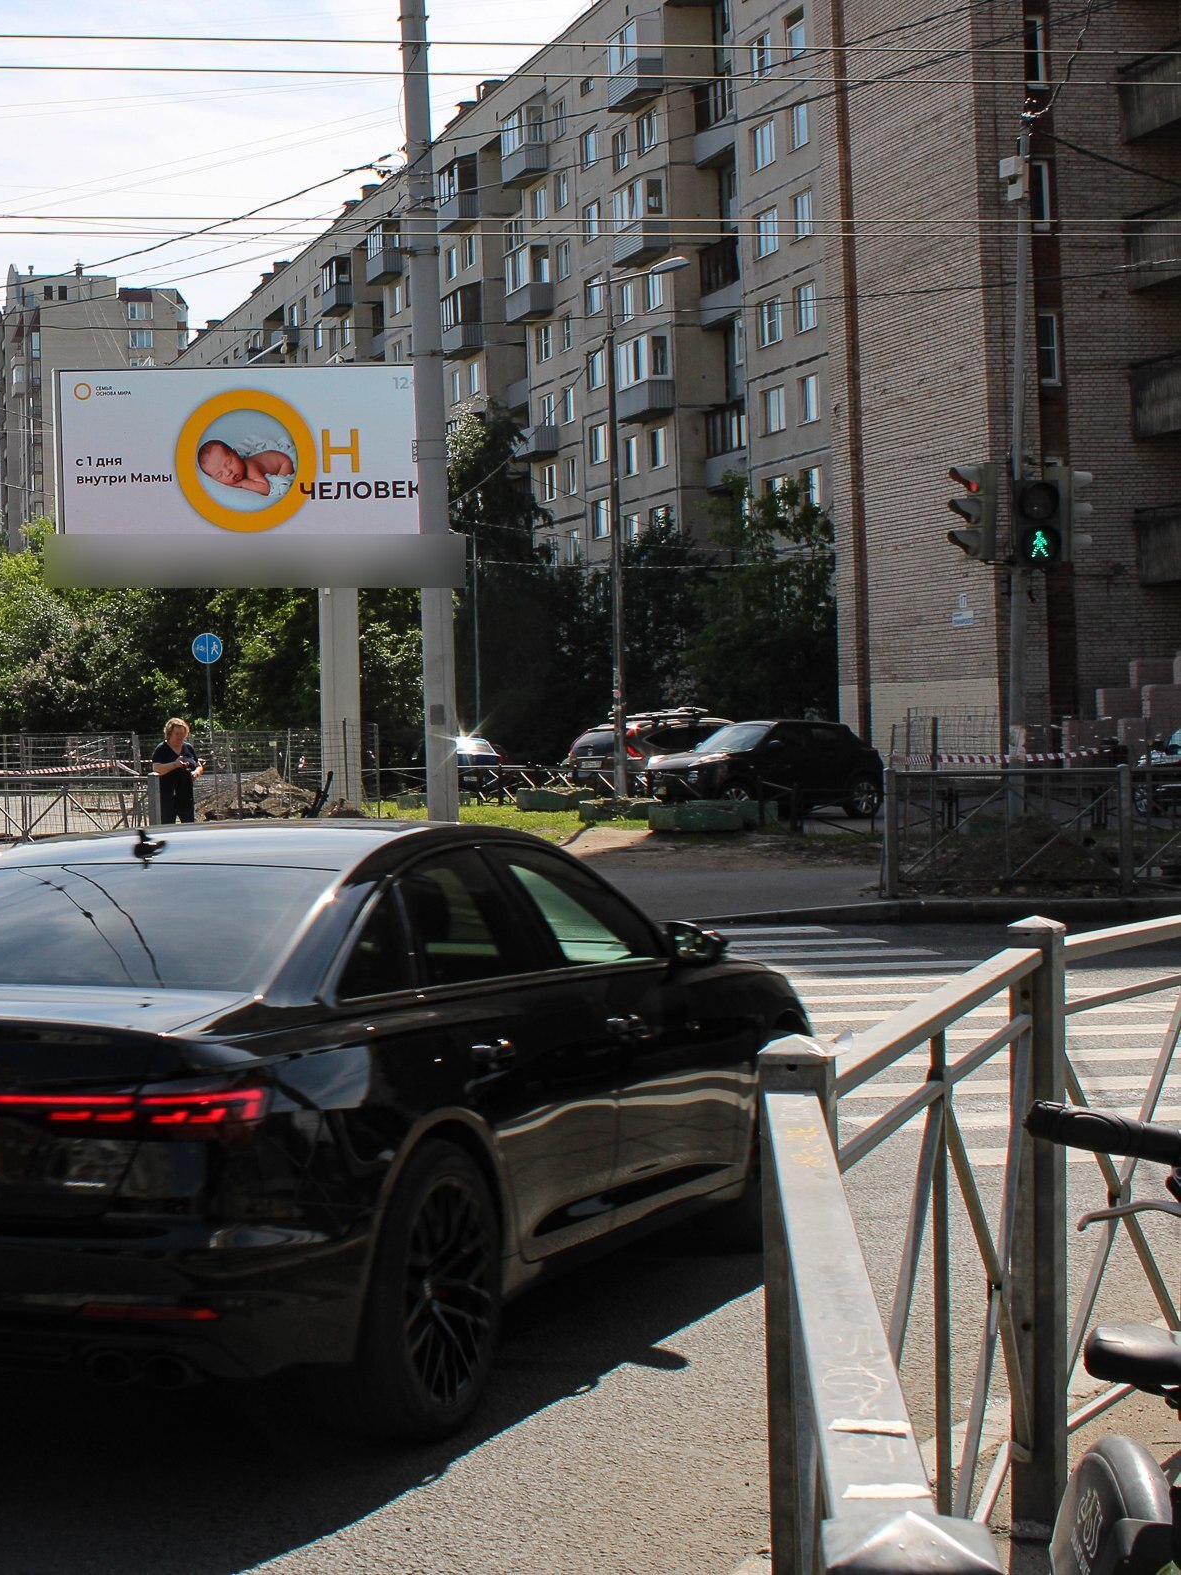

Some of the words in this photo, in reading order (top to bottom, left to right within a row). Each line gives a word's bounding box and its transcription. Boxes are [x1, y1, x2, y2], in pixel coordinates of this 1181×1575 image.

[75, 458, 84, 467] с
[86, 456, 92, 466] 1
[95, 457, 123, 467] дня
[76, 474, 127, 487] внутри
[130, 472, 173, 483] Мамы
